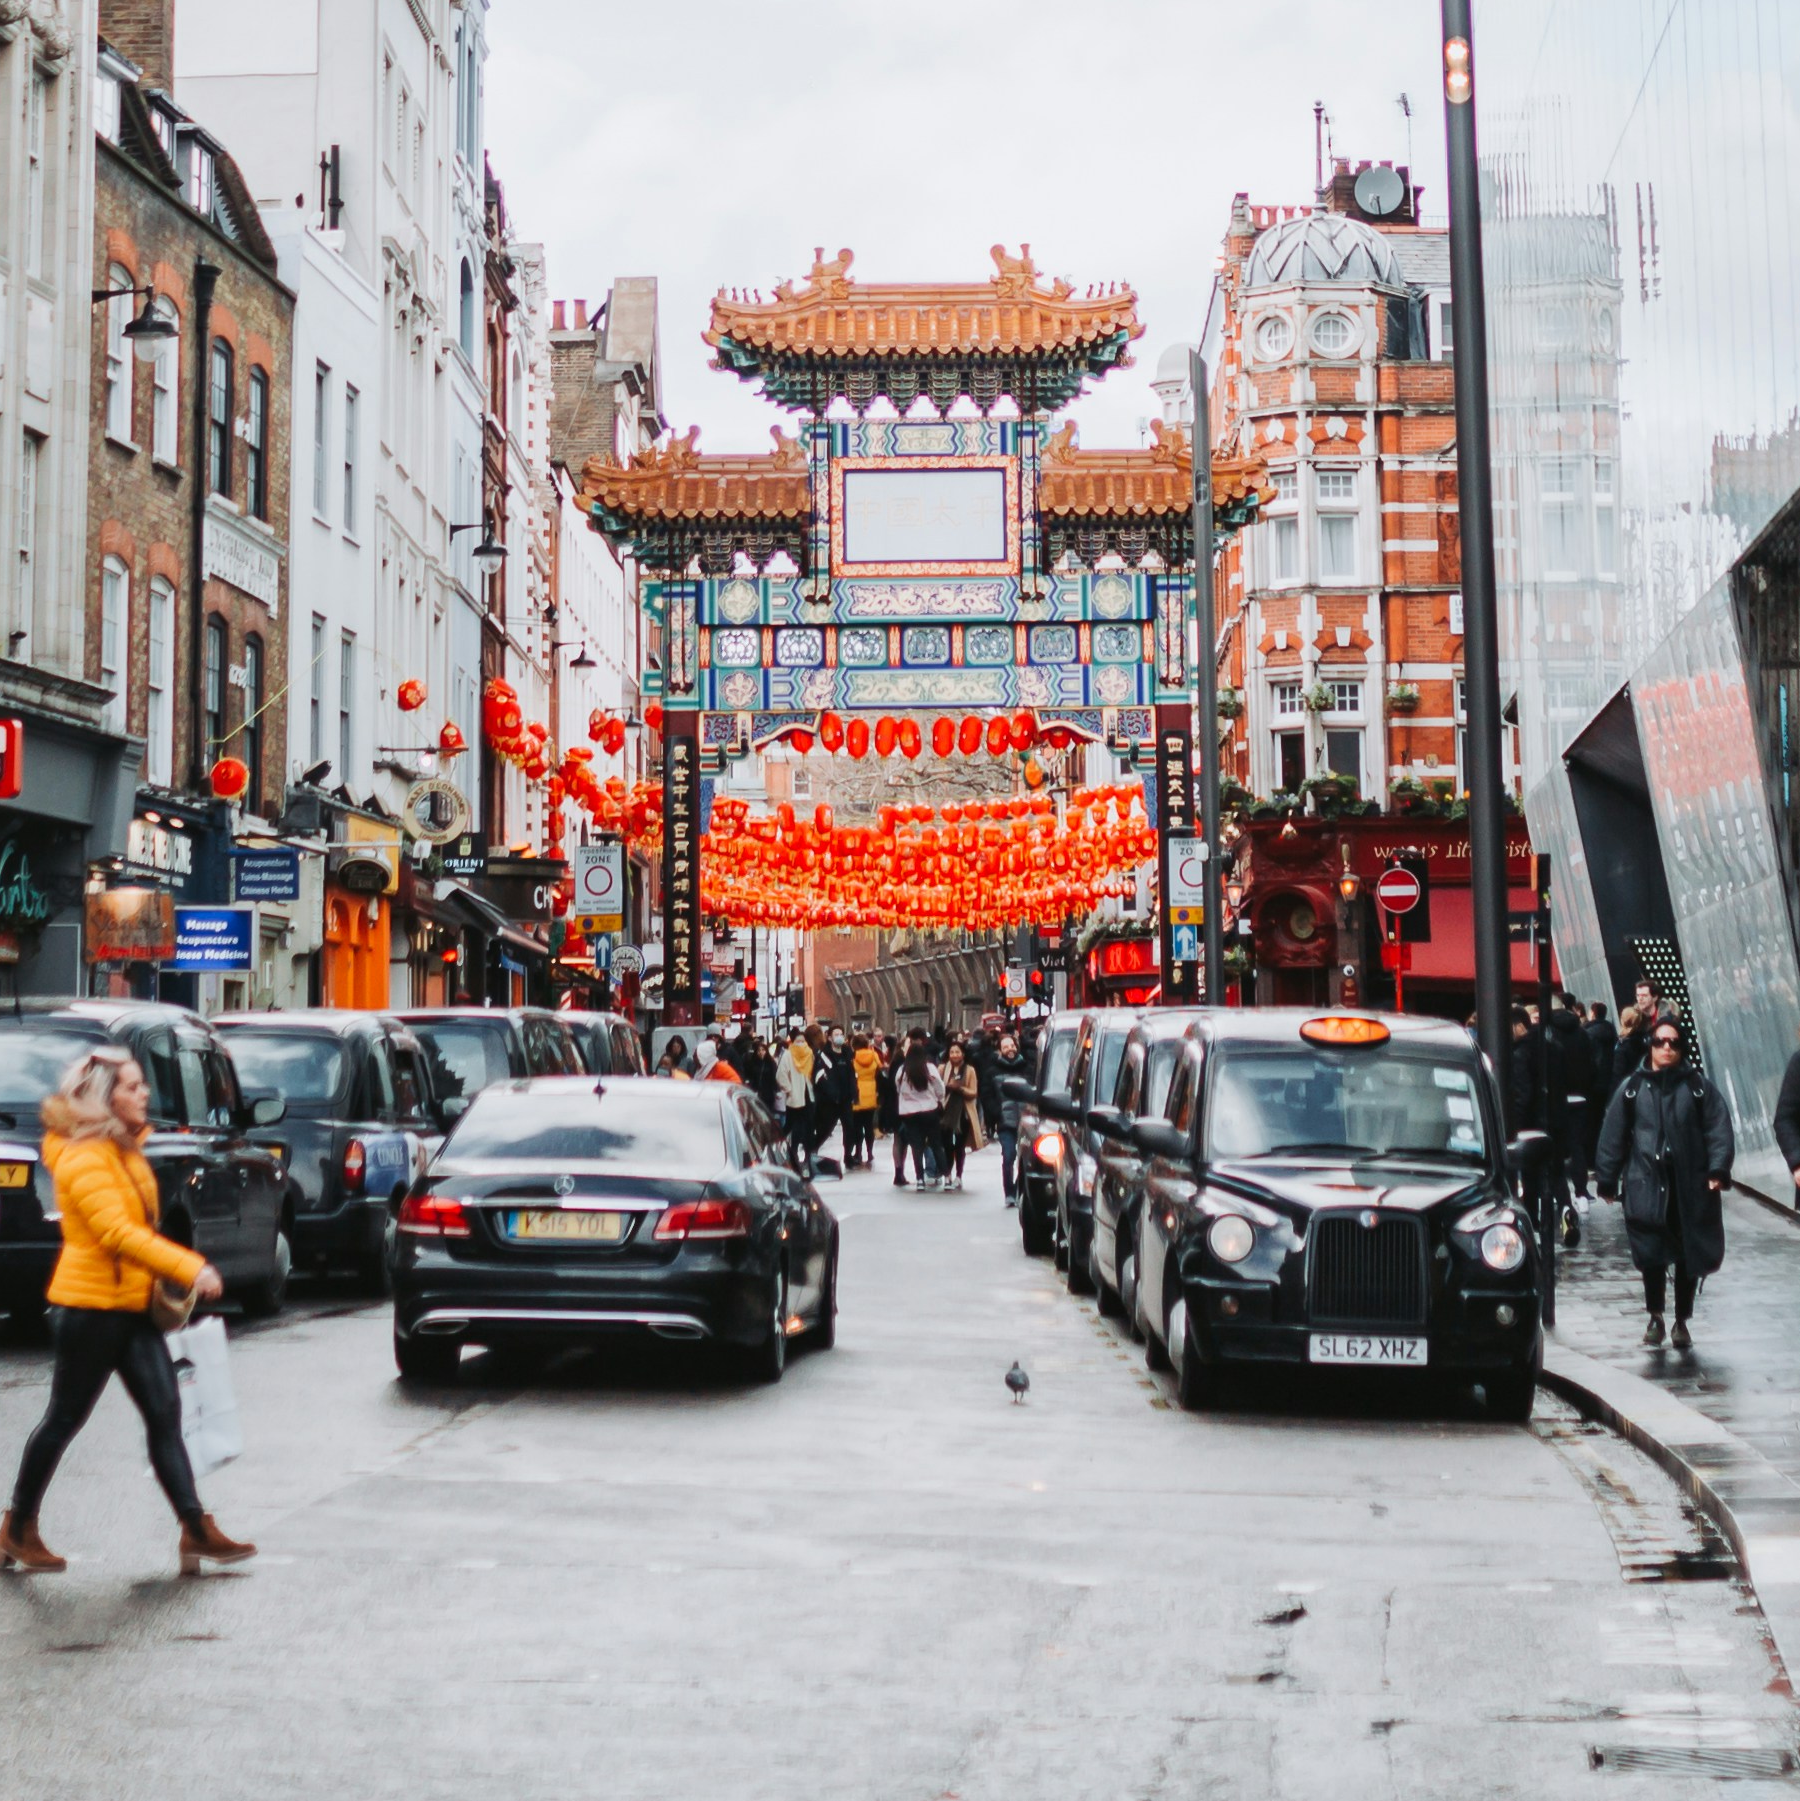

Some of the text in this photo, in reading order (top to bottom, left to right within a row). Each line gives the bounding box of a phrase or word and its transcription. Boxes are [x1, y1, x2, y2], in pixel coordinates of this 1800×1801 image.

[444, 858, 484, 868] ORIENT
[585, 855, 612, 864] ZONE
[185, 919, 227, 932] Massage
[204, 949, 248, 960] Medicine
[1319, 1338, 1418, 1360] SL62 XHZ
